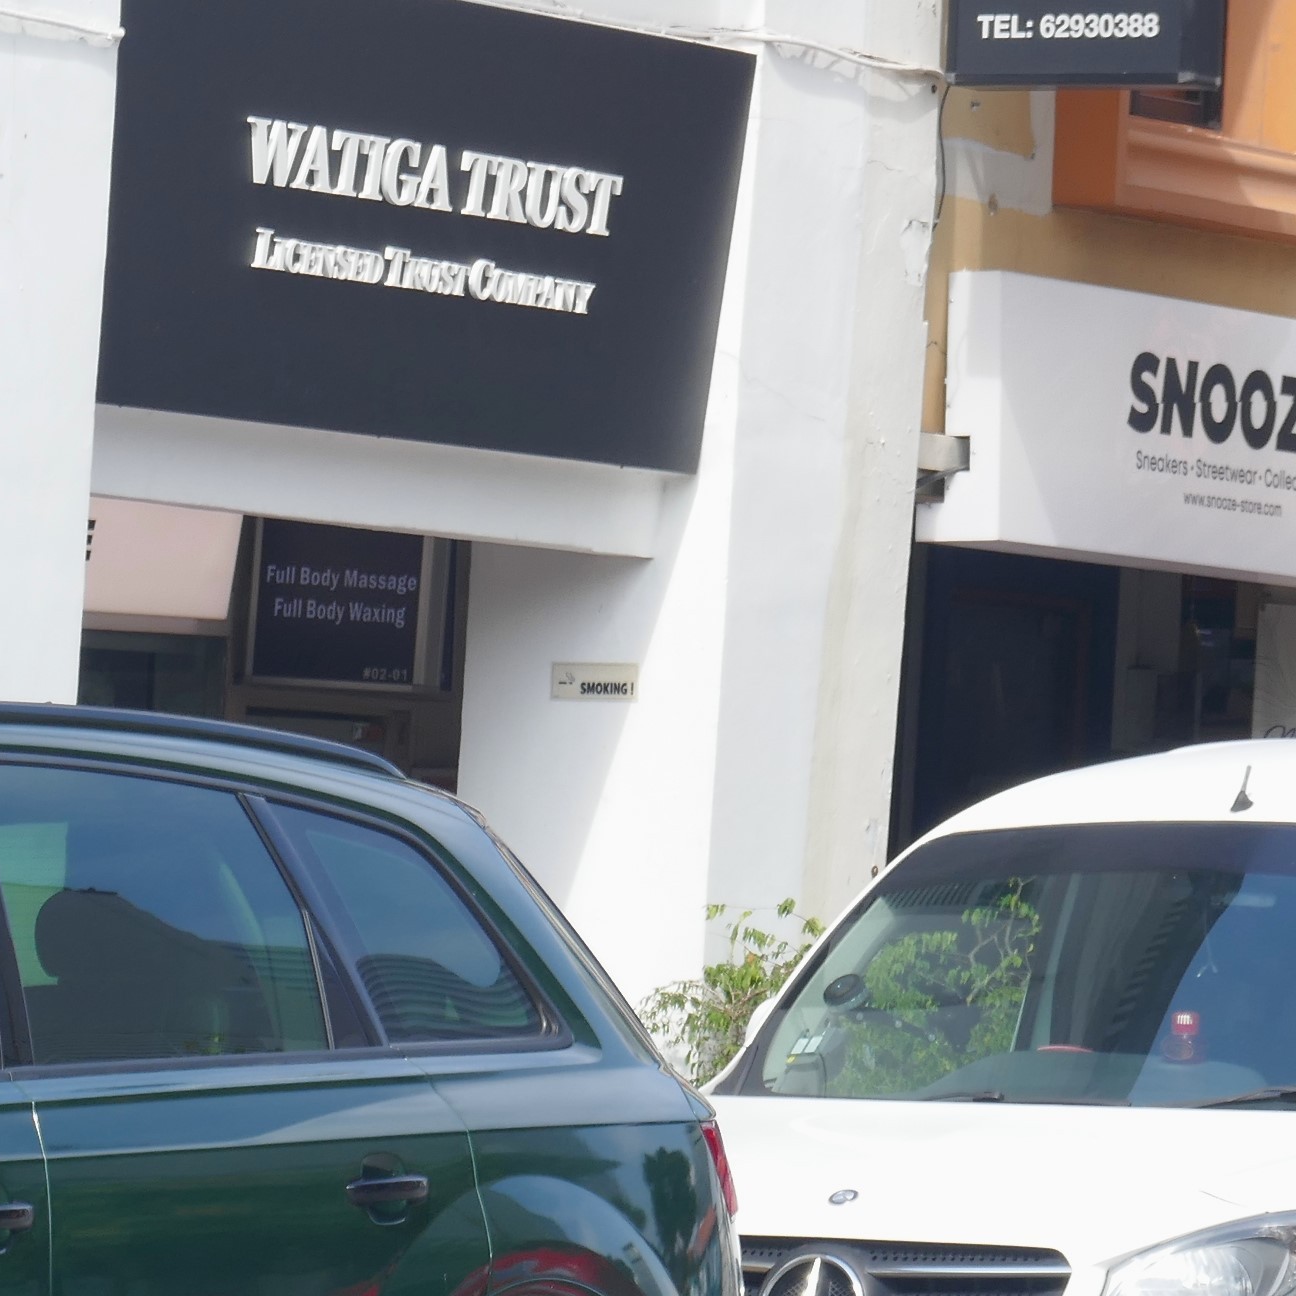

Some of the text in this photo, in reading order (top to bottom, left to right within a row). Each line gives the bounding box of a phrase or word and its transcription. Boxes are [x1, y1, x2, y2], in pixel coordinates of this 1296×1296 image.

[977, 12, 1160, 39] TEL: 62930388
[246, 115, 624, 237] WATIGA TRUST
[1136, 450, 1189, 476] Sneakers
[1196, 458, 1258, 486] Streetwear
[1182, 491, 1283, 517] www.snooze-store.com
[266, 564, 417, 595] Full Body Massage
[274, 597, 406, 629] Full Body Waxing
[362, 667, 408, 682] #02-01
[580, 681, 627, 695] SMOKING
